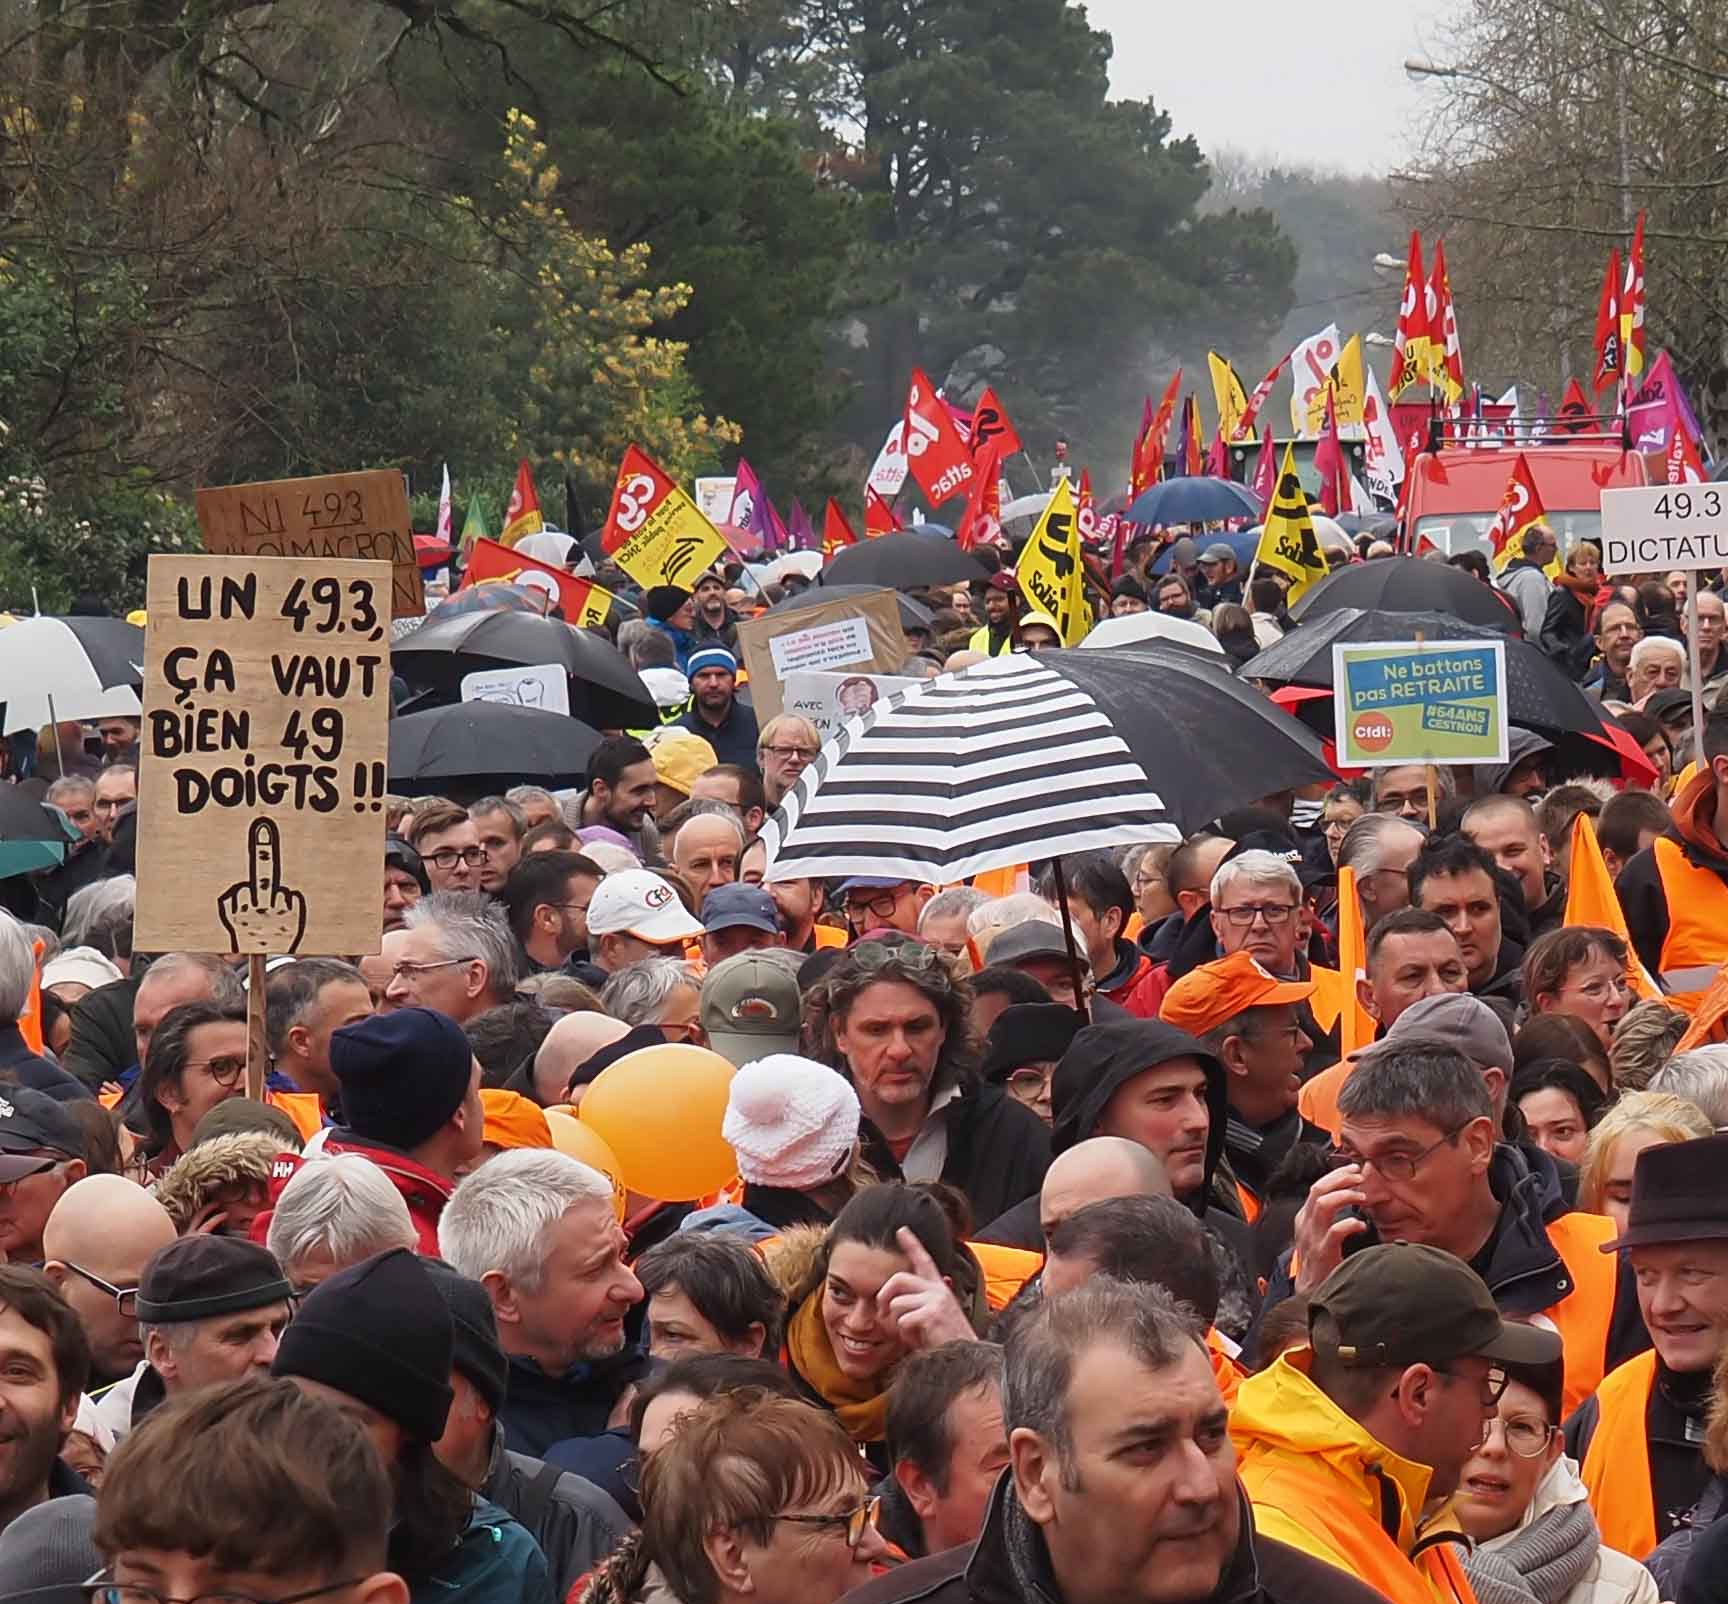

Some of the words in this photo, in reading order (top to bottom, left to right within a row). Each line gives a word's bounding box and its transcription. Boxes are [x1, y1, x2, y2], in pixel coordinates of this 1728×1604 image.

[1653, 490, 1722, 520] 49.3
[177, 573, 257, 620] UN
[163, 646, 235, 705] ÇA
[271, 654, 382, 698] VAUT
[1383, 662, 1410, 680] Ne
[1411, 656, 1483, 679] battons
[1354, 686, 1388, 707] pas
[1390, 674, 1485, 700] RETRAITE
[1425, 704, 1486, 723] #64ANS
[280, 707, 344, 762] 49
